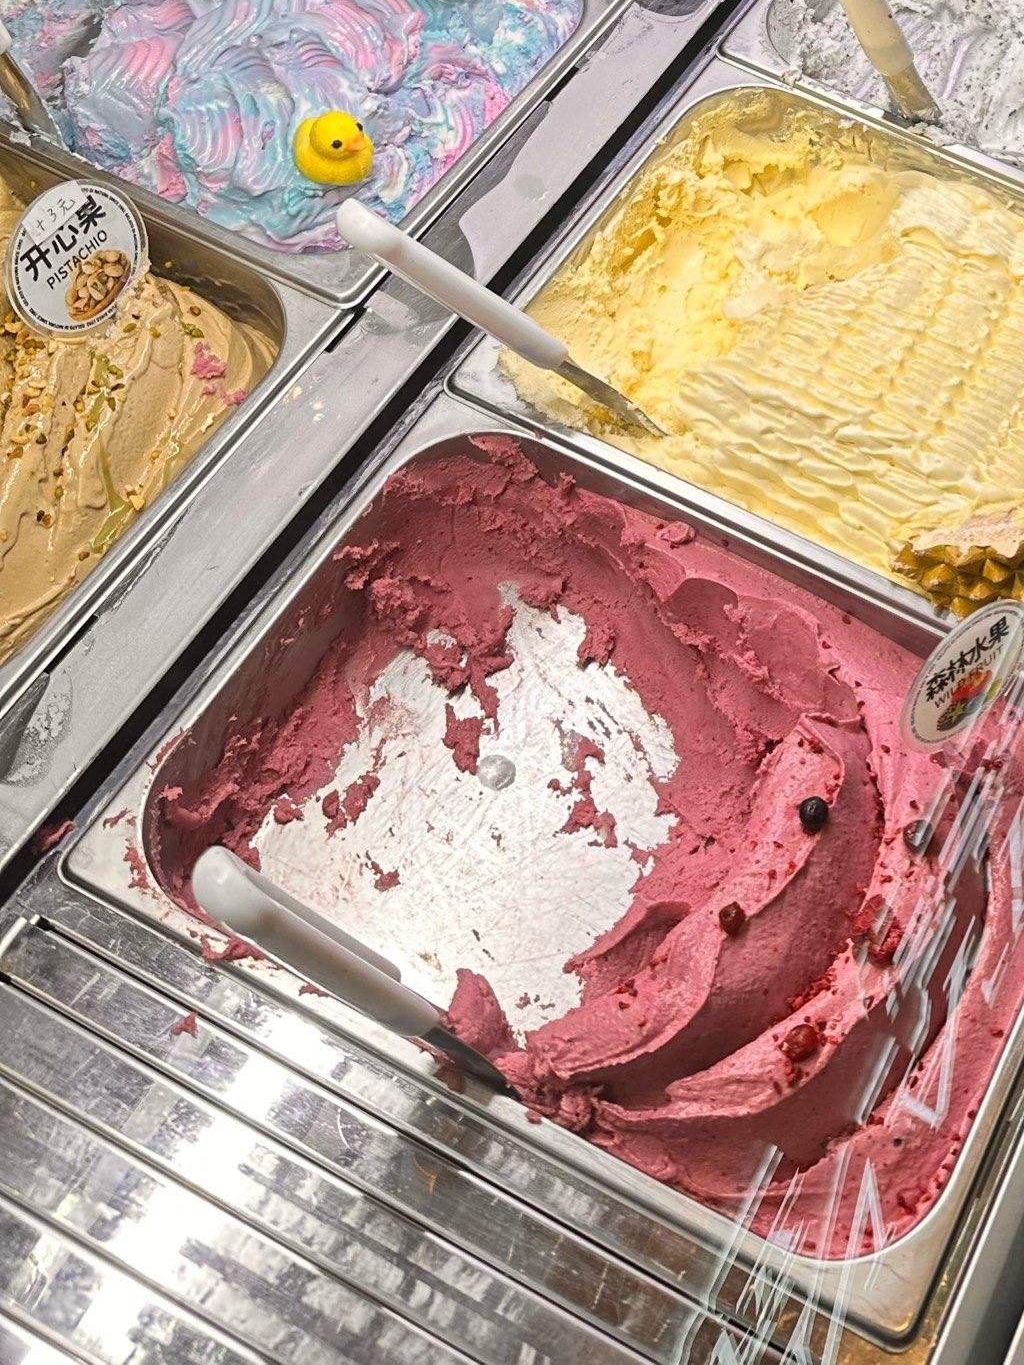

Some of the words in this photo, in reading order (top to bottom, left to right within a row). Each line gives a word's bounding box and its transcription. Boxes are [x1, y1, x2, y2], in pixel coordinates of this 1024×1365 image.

[20, 194, 107, 282] 开心果
[46, 229, 108, 290] PISTACHIO
[926, 616, 1010, 702] 森林水果
[934, 678, 967, 709] WILD
